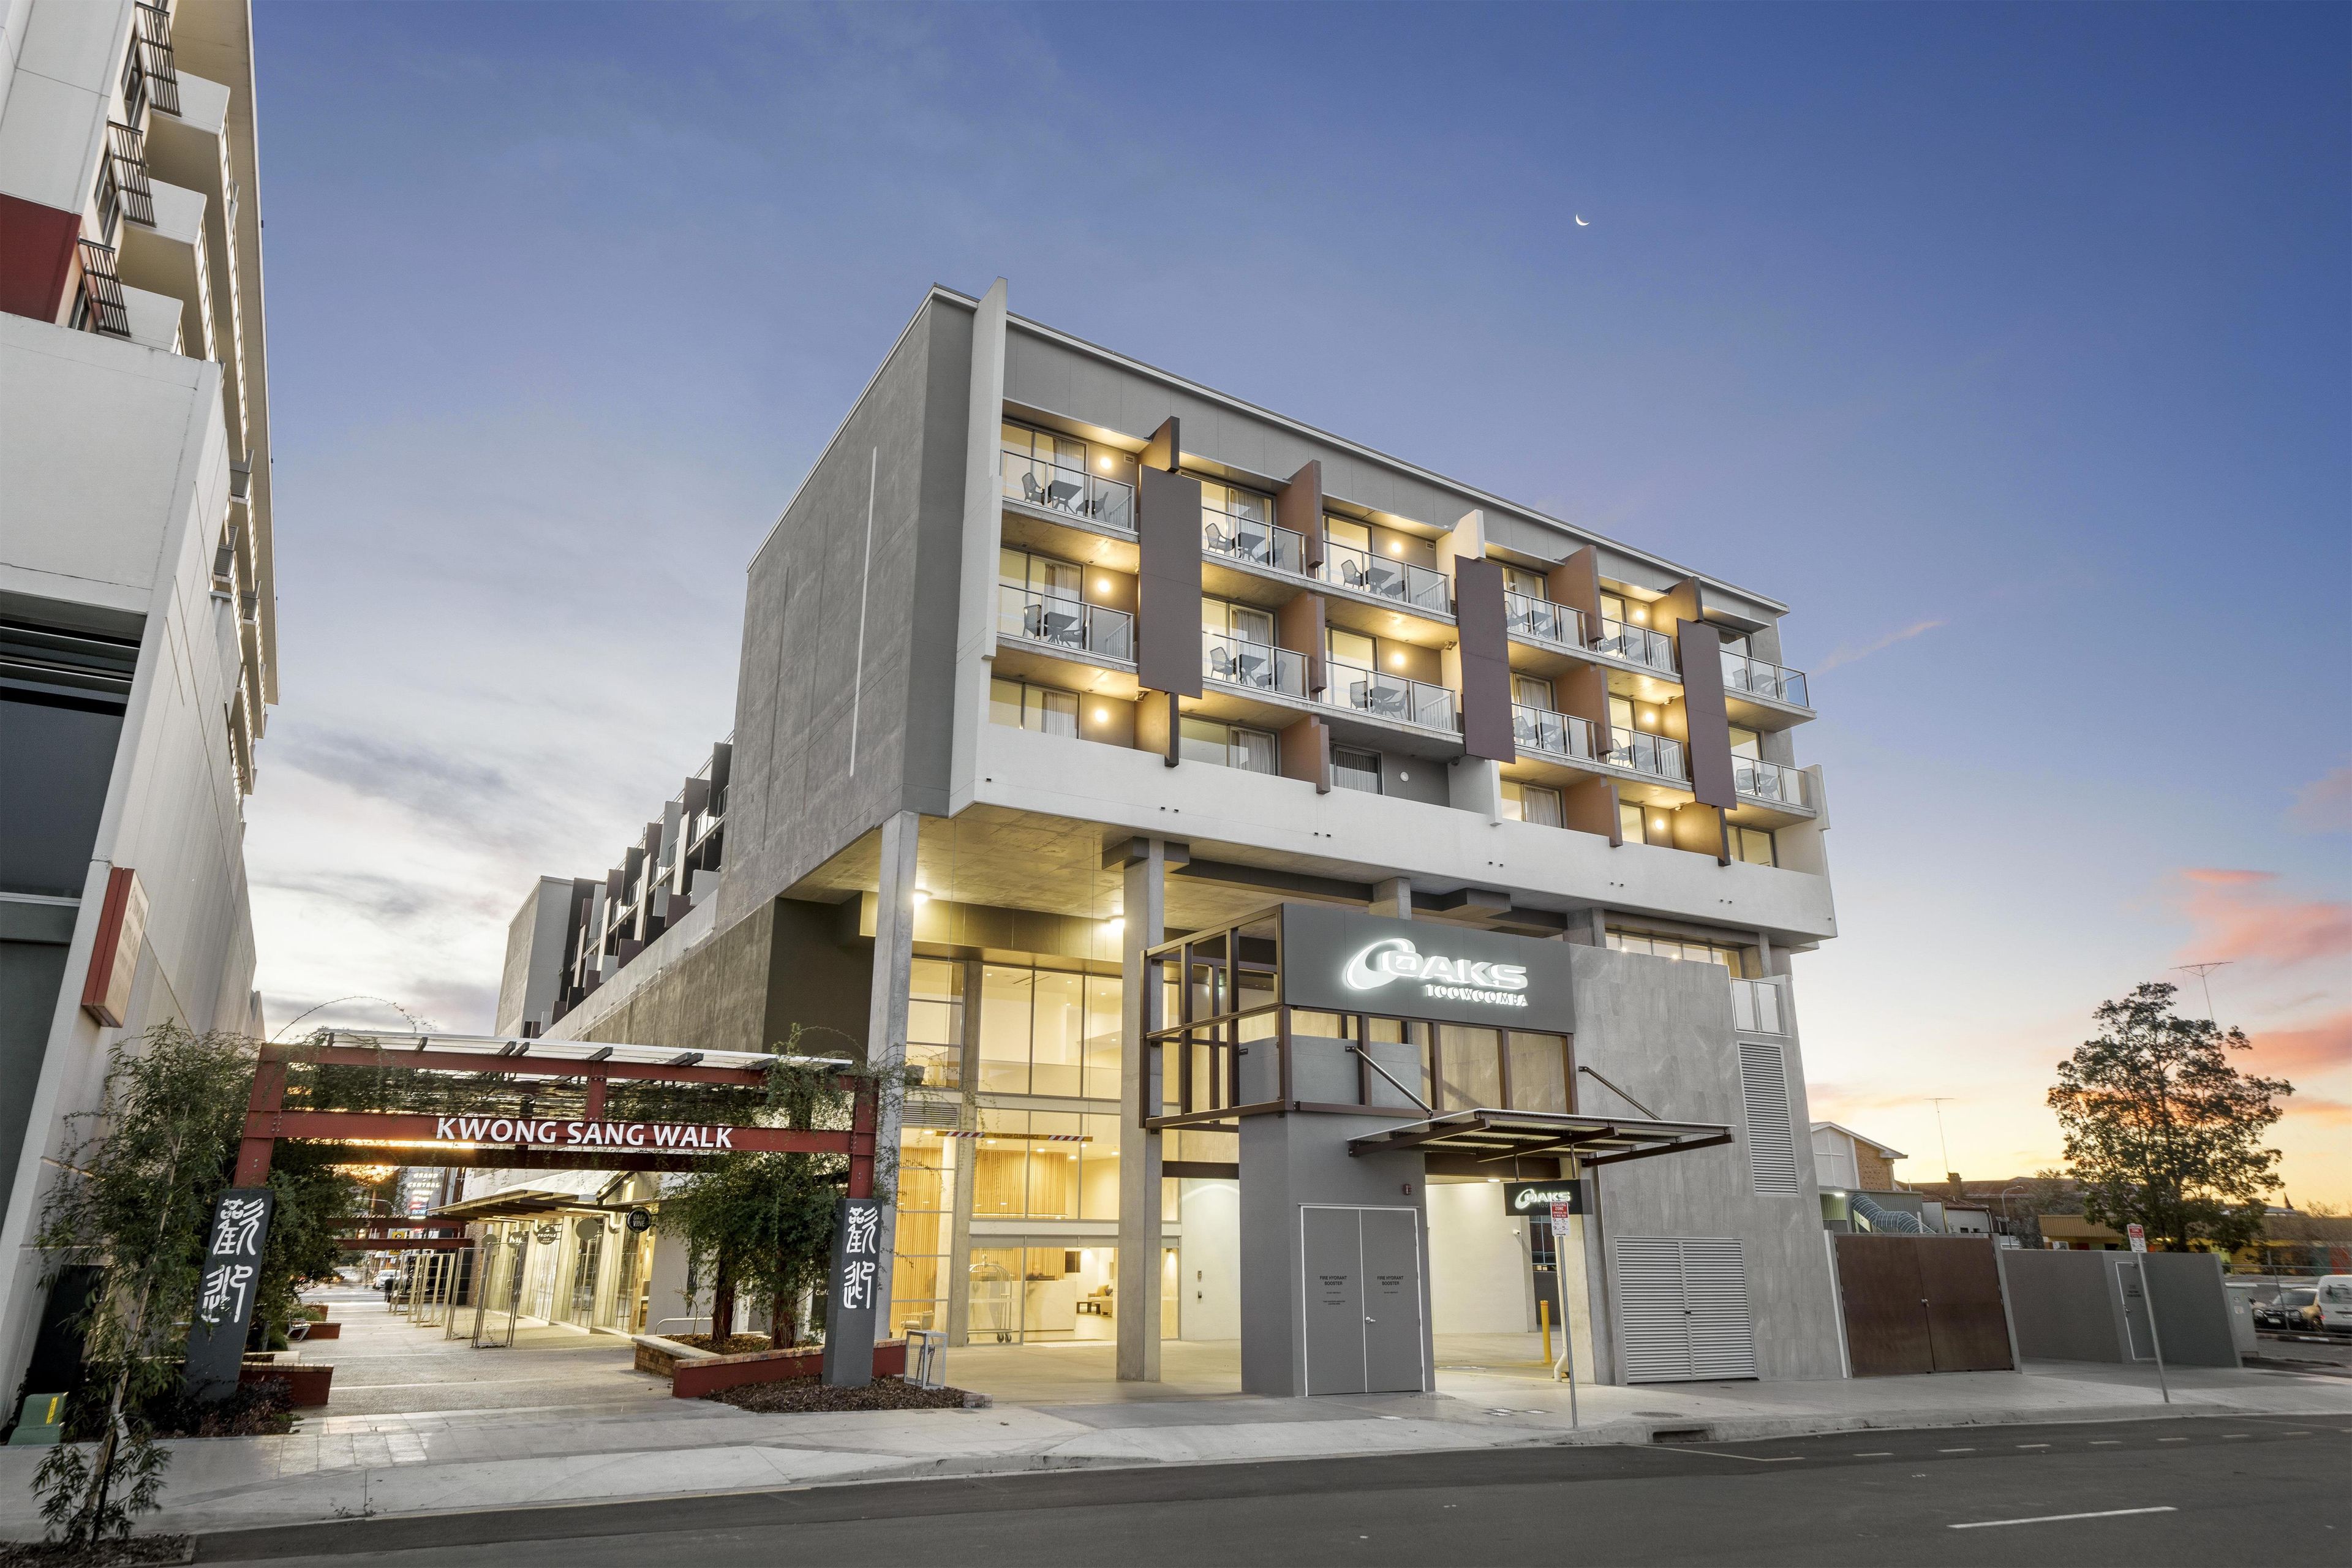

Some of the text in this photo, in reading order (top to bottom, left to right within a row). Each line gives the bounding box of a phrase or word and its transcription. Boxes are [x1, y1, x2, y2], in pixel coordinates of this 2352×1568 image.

[1378, 948, 1528, 990] OAKS
[1425, 984, 1529, 1006] TOOWOOMBA
[436, 1117, 733, 1148] KWONG SANG WALK
